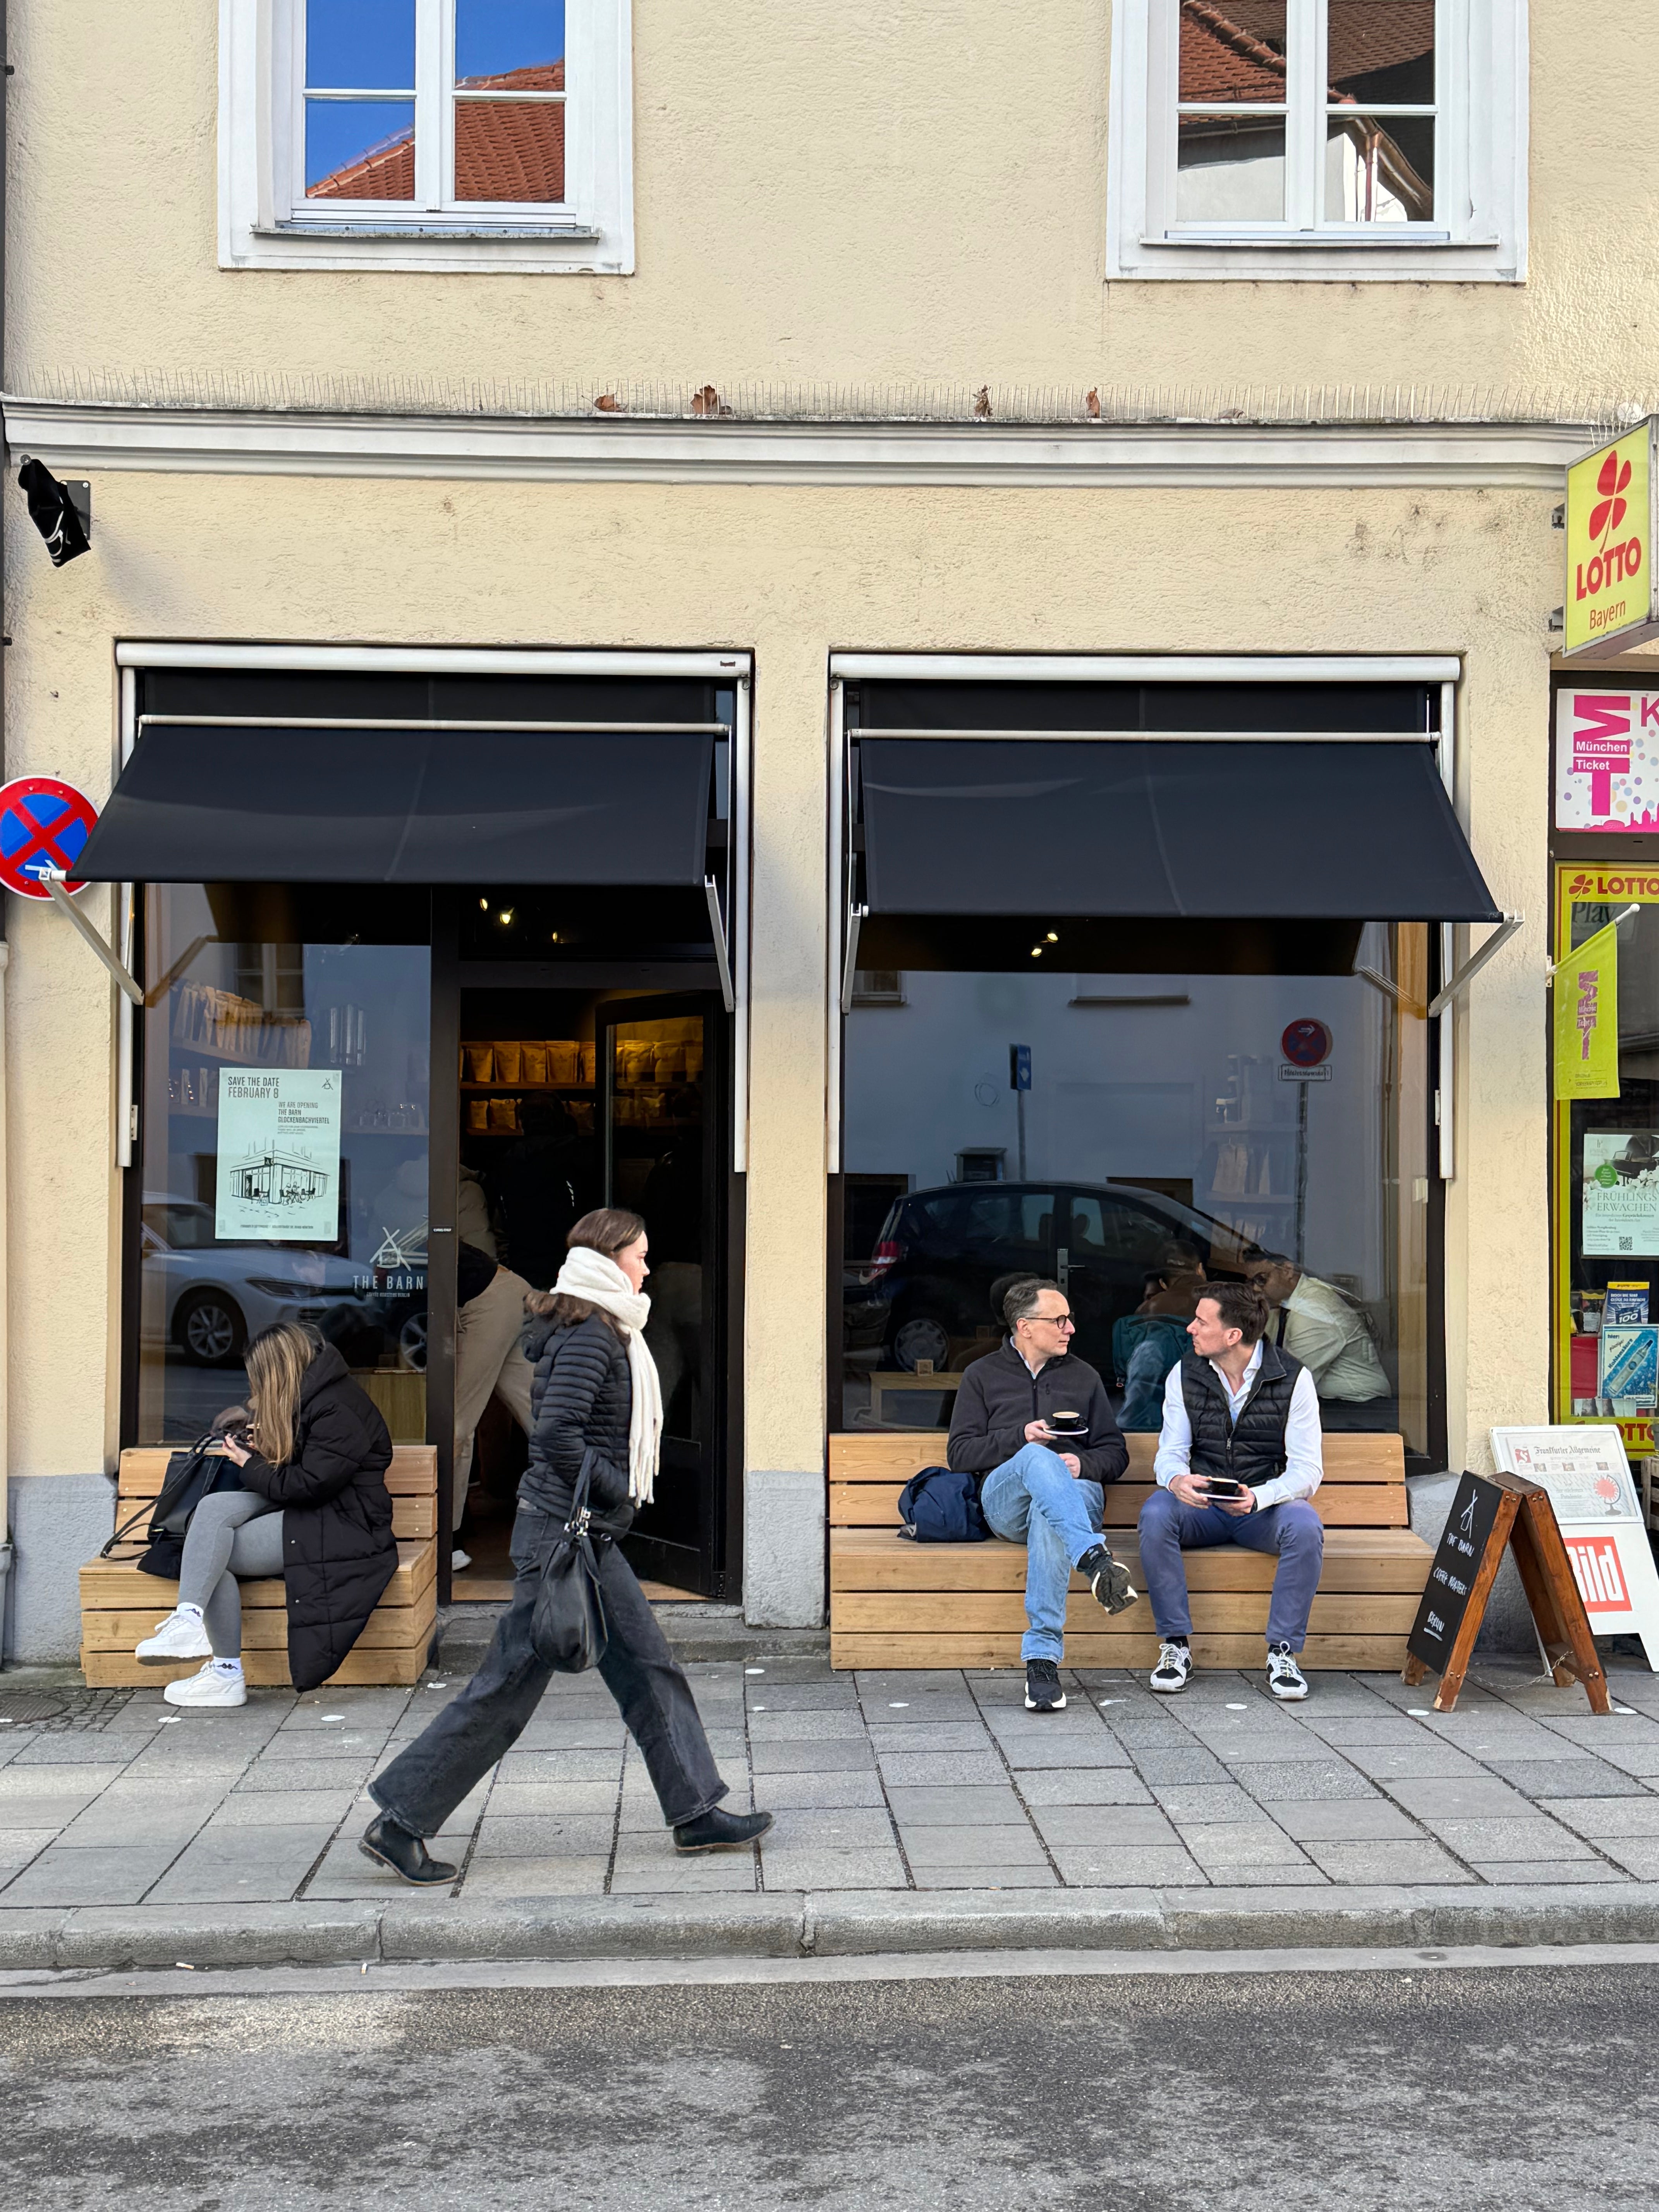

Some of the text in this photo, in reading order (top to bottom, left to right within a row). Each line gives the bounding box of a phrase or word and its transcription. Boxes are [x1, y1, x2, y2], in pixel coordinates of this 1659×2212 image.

[1577, 537, 1642, 601] LOTTO
[1590, 601, 1625, 630] Bayern
[1576, 741, 1627, 752] München
[1576, 759, 1610, 770] Ticket
[1597, 877, 1659, 895] LOTTO
[228, 1077, 279, 1087] SAVE THE DATE
[228, 1087, 278, 1098] FEBRUARY 8
[1597, 1191, 1657, 1202] FRÜHLINGS
[1597, 1202, 1657, 1212] ERWACHEN
[353, 1276, 424, 1290] THE BARN
[1619, 1313, 1638, 1323] 100
[1534, 1445, 1601, 1455] Frankfurter Allgemeine
[1447, 1533, 1475, 1557] THE BARN
[1433, 1567, 1448, 1585] COFFEE
[1427, 1611, 1444, 1632] BERLIN
